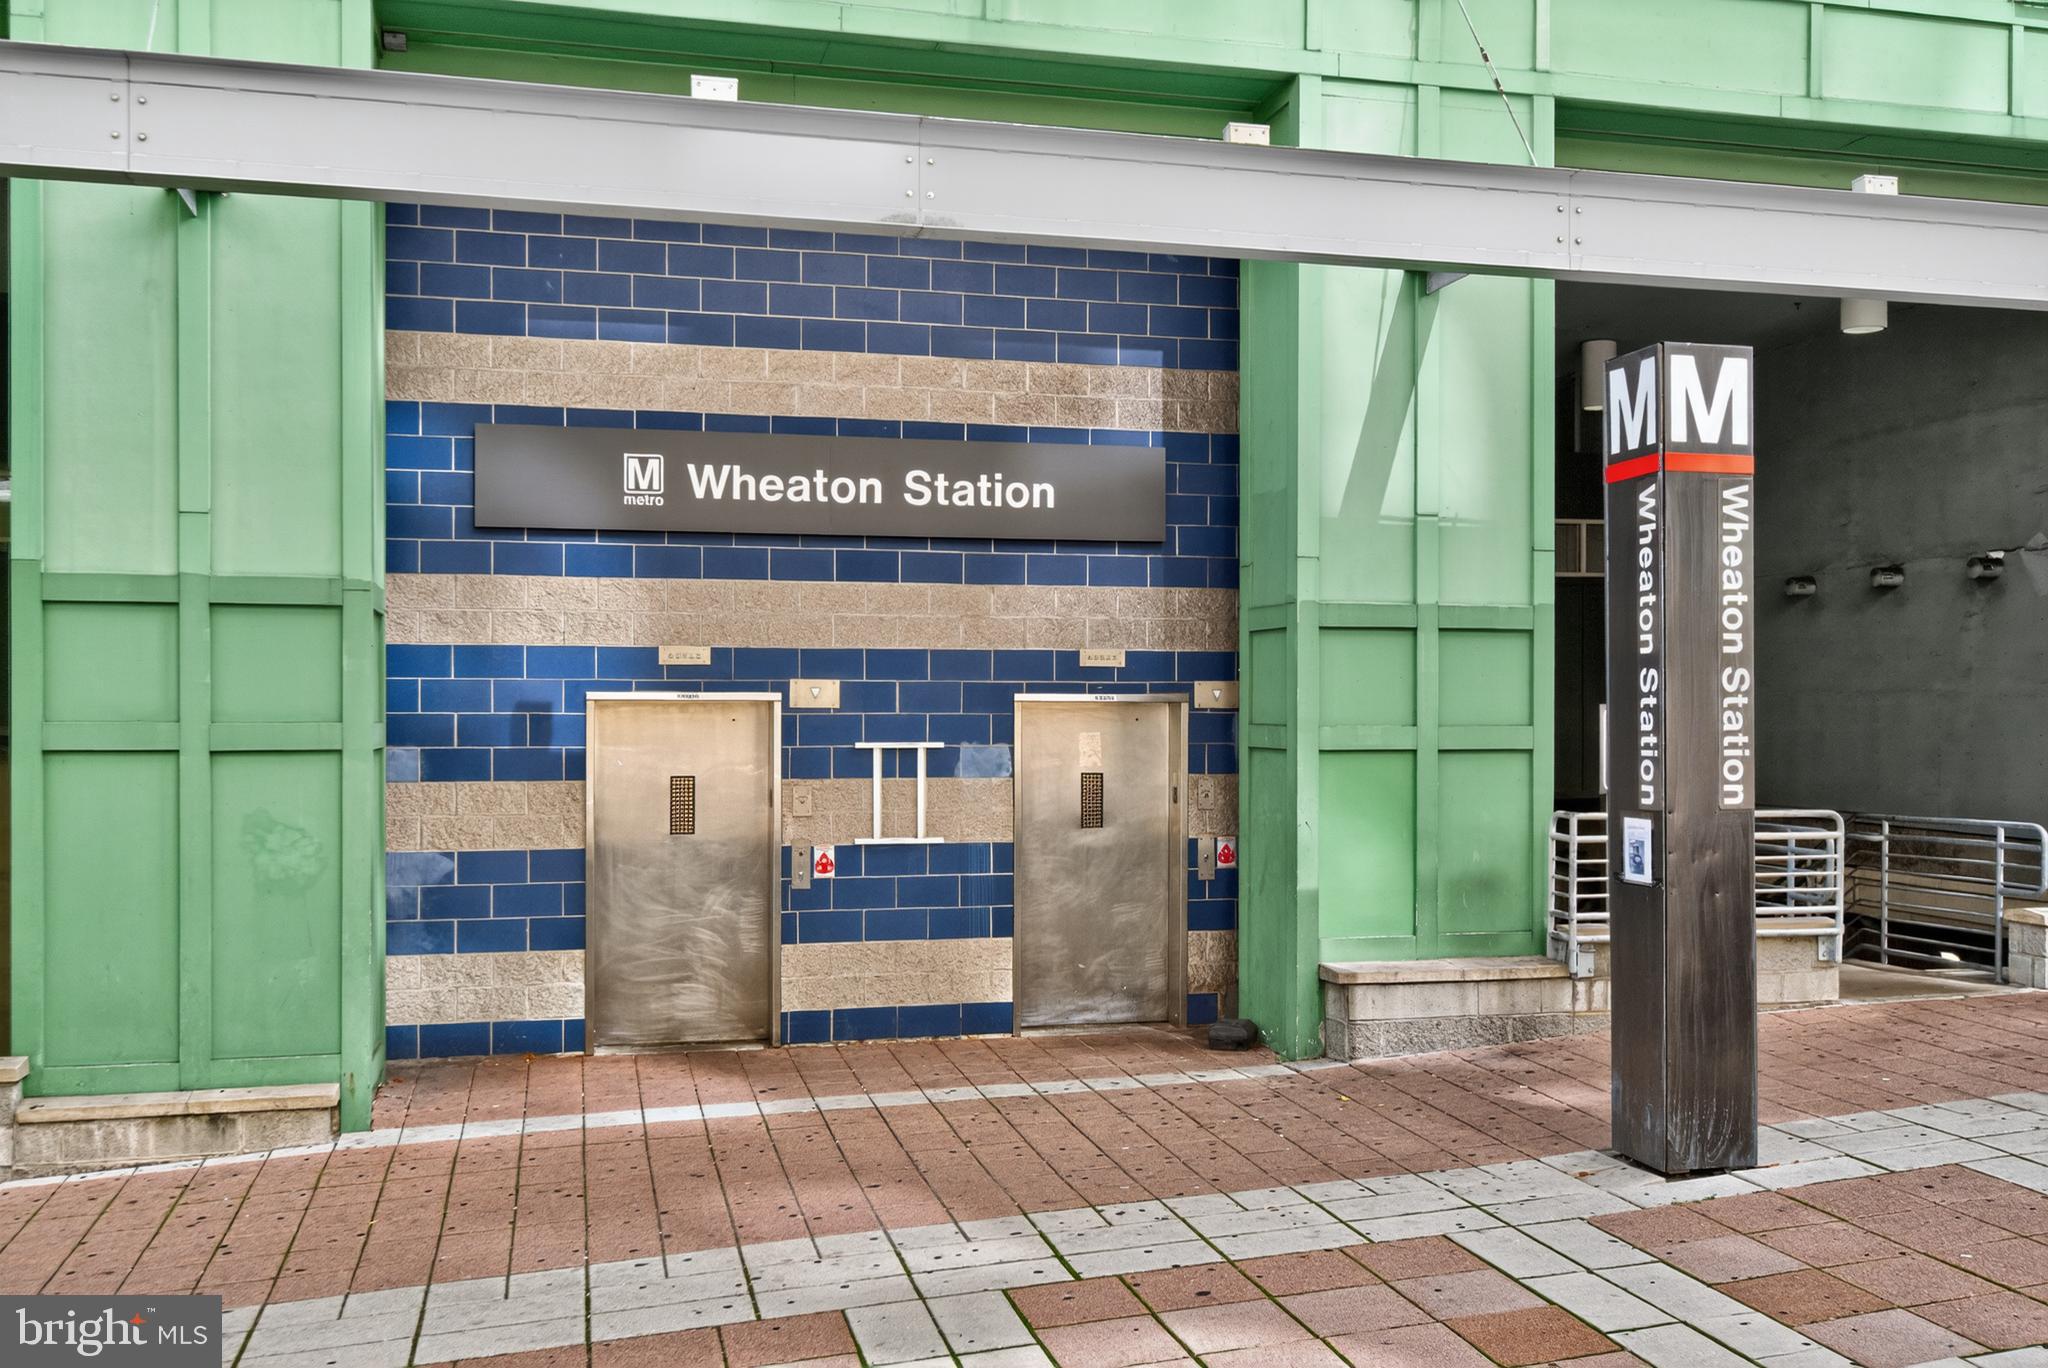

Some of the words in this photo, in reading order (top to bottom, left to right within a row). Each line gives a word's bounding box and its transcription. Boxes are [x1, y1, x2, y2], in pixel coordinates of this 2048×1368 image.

[1608, 356, 1657, 456] M
[1670, 354, 1749, 446] M
[623, 493, 664, 507] metro
[627, 458, 660, 491] M
[686, 463, 883, 504] Wheaton
[903, 469, 1056, 509] Station
[1638, 484, 1657, 655] Wheaton
[1721, 484, 1750, 655] Wheaton
[1639, 667, 1659, 806] Station
[1721, 666, 1751, 806] Station
